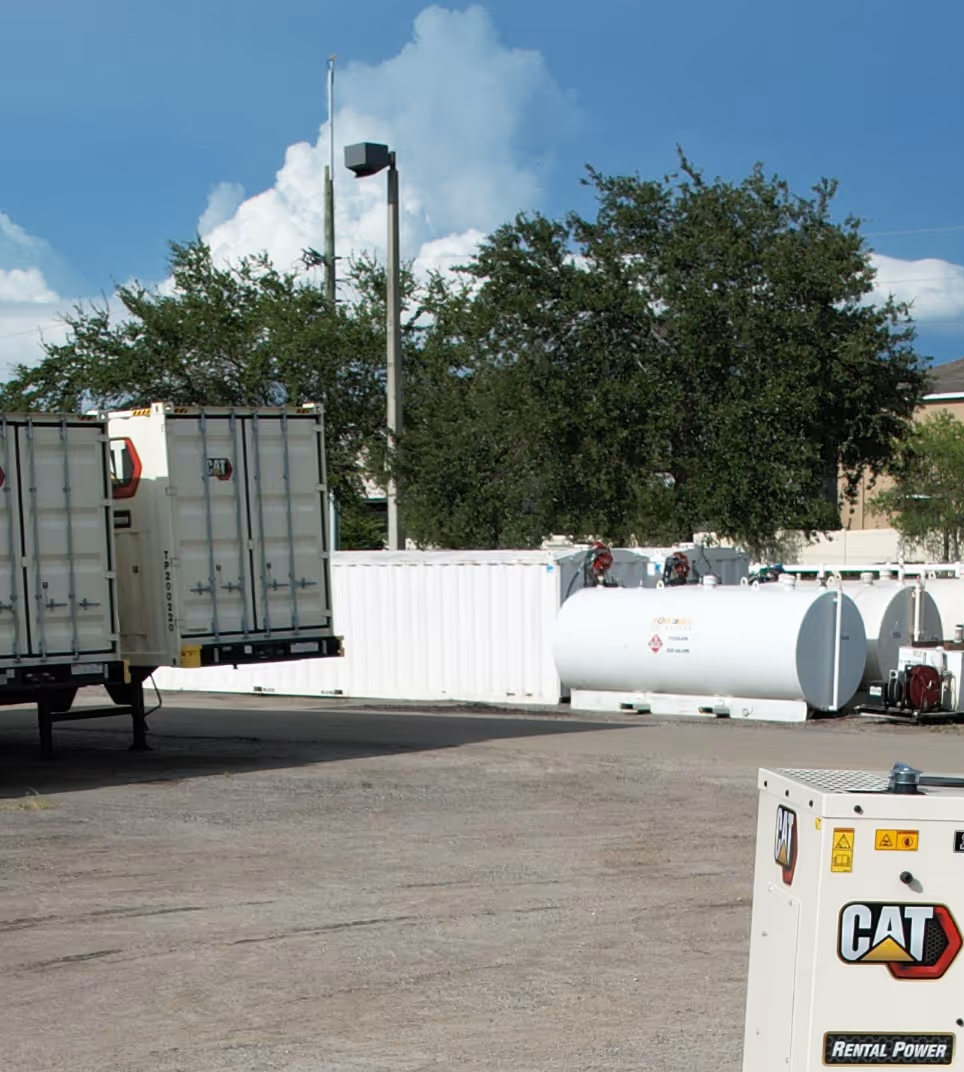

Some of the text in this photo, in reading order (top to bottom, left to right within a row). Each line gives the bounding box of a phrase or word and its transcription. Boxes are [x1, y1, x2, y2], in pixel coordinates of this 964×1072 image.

[207, 459, 226, 475] CAT
[775, 806, 794, 867] CAT
[841, 904, 934, 962] CAT
